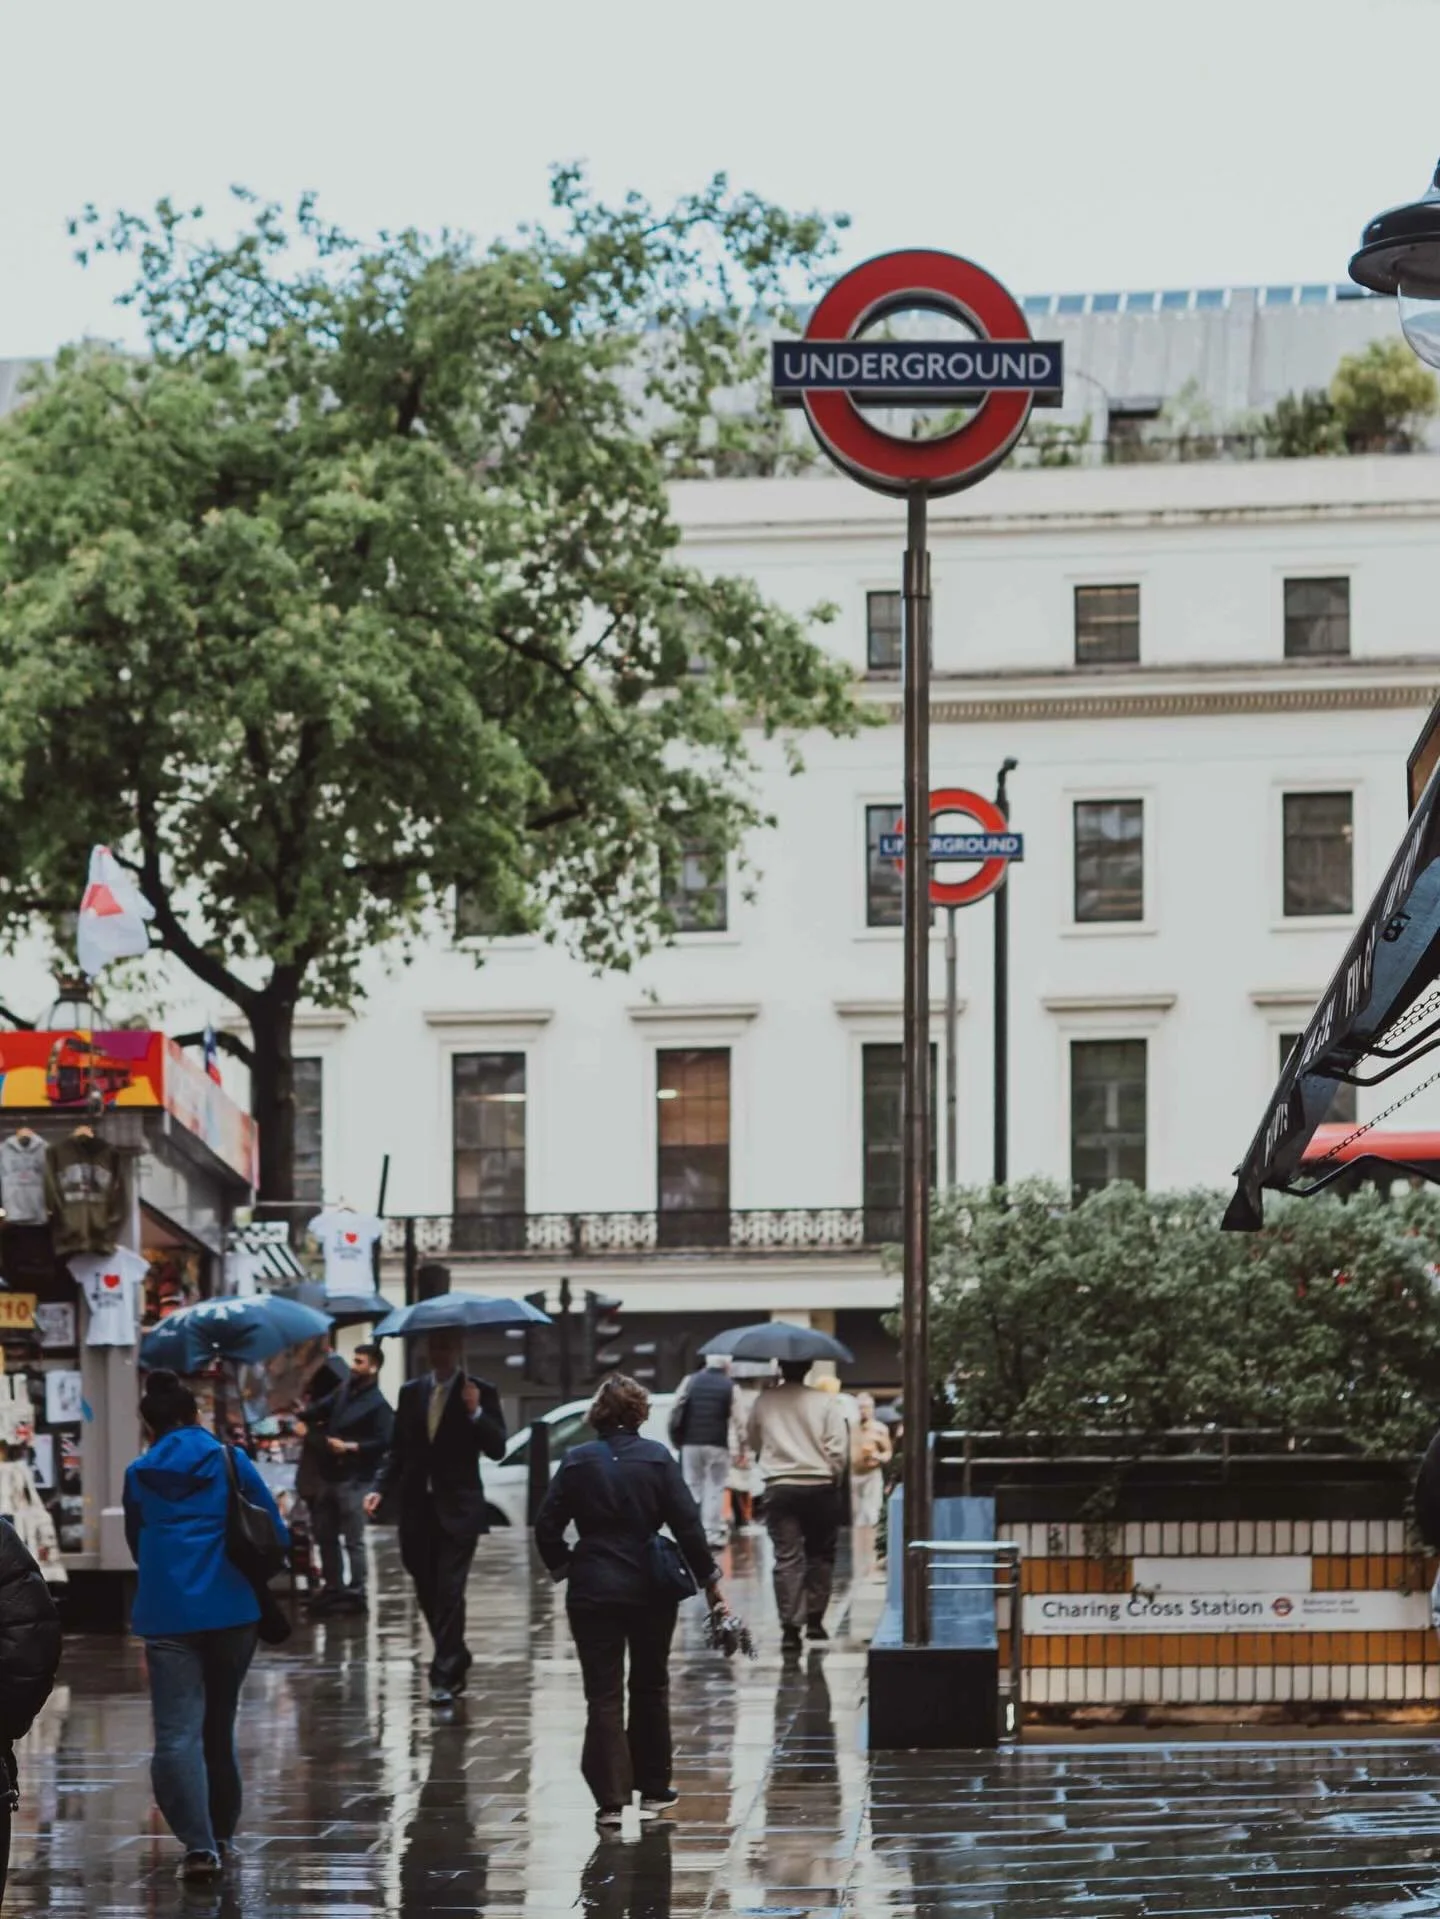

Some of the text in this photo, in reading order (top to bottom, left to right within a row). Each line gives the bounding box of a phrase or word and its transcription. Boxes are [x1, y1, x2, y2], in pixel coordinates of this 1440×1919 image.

[783, 352, 1052, 380] UNDERGROUND
[1042, 1600, 1121, 1620] Charing
[1127, 1600, 1184, 1617] Cross
[1189, 1599, 1264, 1616] Station
